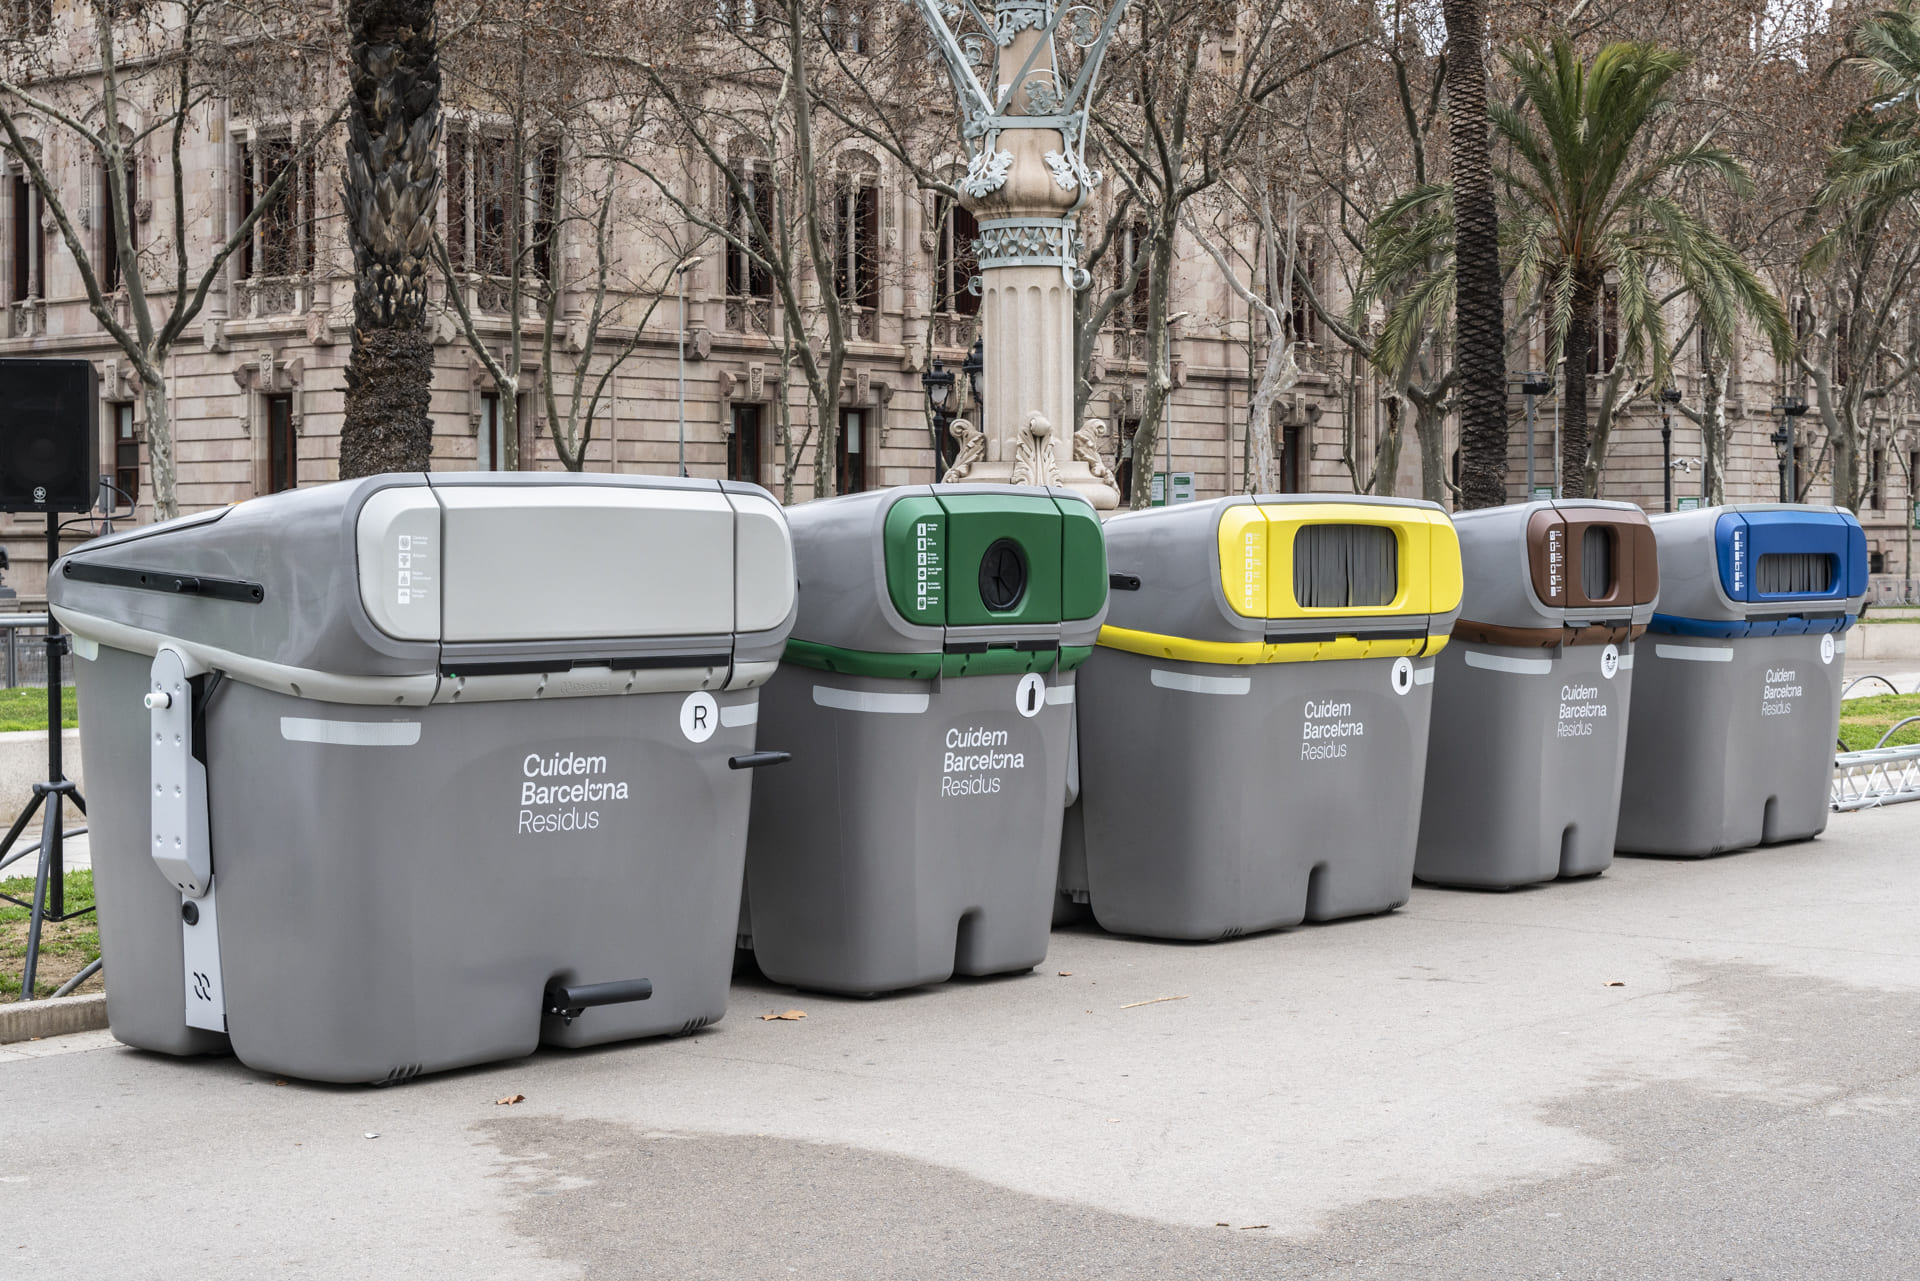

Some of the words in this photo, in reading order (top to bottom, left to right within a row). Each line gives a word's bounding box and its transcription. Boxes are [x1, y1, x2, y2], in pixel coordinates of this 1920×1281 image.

[1765, 668, 1796, 683] Cuidem
[1560, 684, 1598, 701] Cuidem
[1763, 684, 1803, 700] Barcelona
[692, 705, 708, 730] R
[1304, 699, 1352, 719] Cuidem
[1559, 701, 1608, 719] Barcelona
[1761, 700, 1792, 717] Residus
[945, 726, 1008, 748] Cuidem
[1303, 719, 1364, 740] Barcelona
[1557, 719, 1593, 738] Residus
[943, 749, 1025, 773] Barcelona
[1301, 740, 1348, 761] Residus
[522, 752, 607, 778] Cuidem
[520, 778, 630, 806] Barcelona
[941, 773, 1001, 798] Residus
[517, 807, 600, 834] Residus
